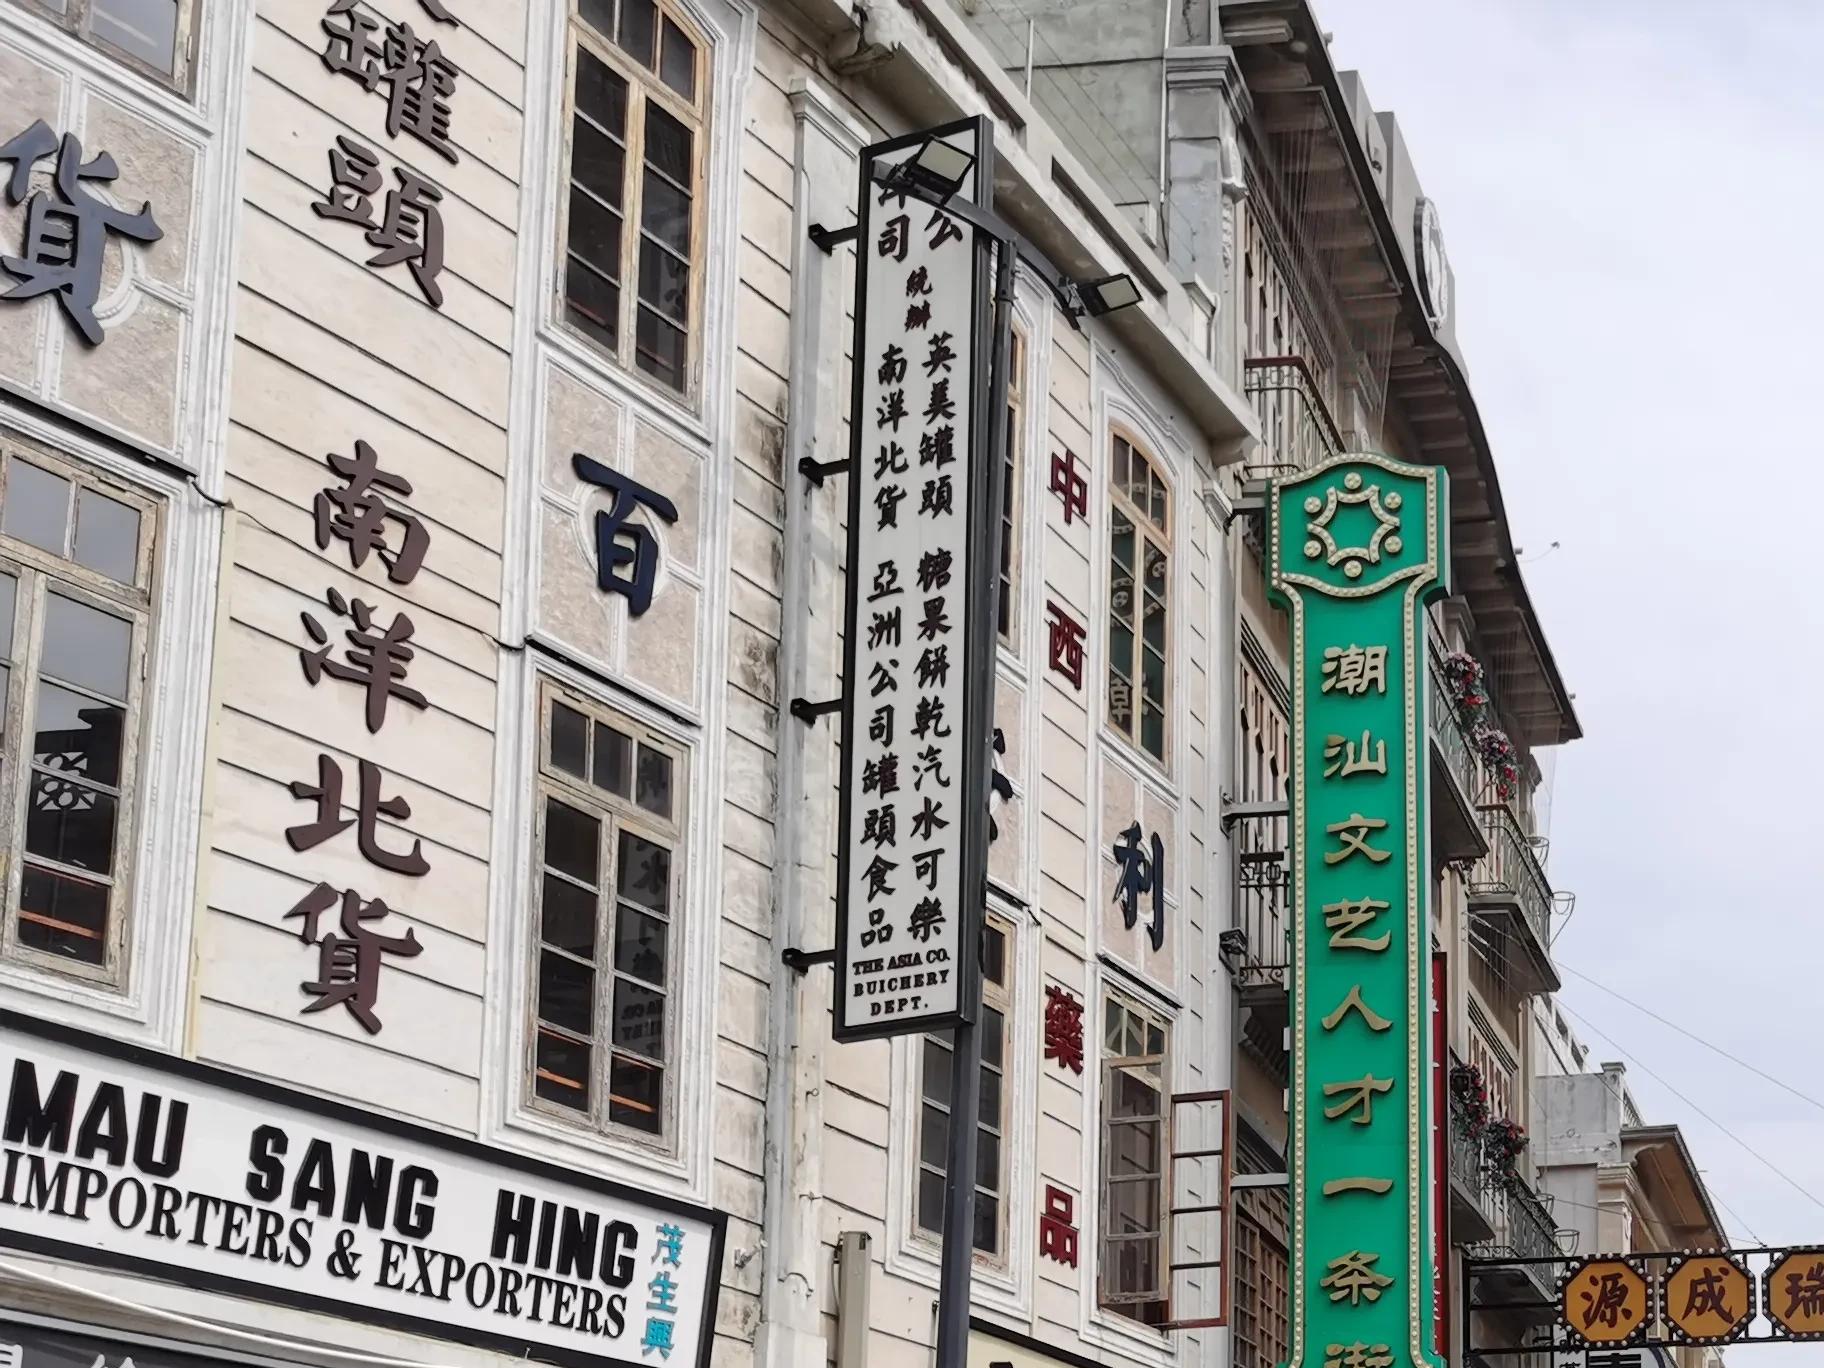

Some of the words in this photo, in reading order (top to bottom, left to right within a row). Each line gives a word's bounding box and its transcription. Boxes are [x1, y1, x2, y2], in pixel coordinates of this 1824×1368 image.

[0, 118, 164, 346] 貨
[311, 0, 461, 308] 罐頭
[873, 343, 909, 532] 南洋北貨
[917, 332, 958, 520] 英美罐頭
[572, 453, 679, 617] 百
[283, 440, 431, 1035] 南洋北貨
[860, 559, 904, 948] 亞洲公司罐頭食品
[906, 547, 954, 943] 糖果餅乾汽水可樂
[1039, 447, 1090, 1271] 中西藥品
[1113, 820, 1164, 953] 利
[852, 957, 885, 978] THE
[886, 950, 923, 972] ASIA
[925, 948, 951, 966] CO.
[870, 995, 929, 1017] DEPT.
[1, 1148, 314, 1270] IMPORTERS
[326, 1227, 362, 1280] &
[374, 1241, 627, 1341] EXPORTERS
[3, 1057, 189, 1179] MAU
[245, 1123, 439, 1240] SANG
[489, 1188, 639, 1289] HING
[639, 1222, 688, 1360] 茂生興
